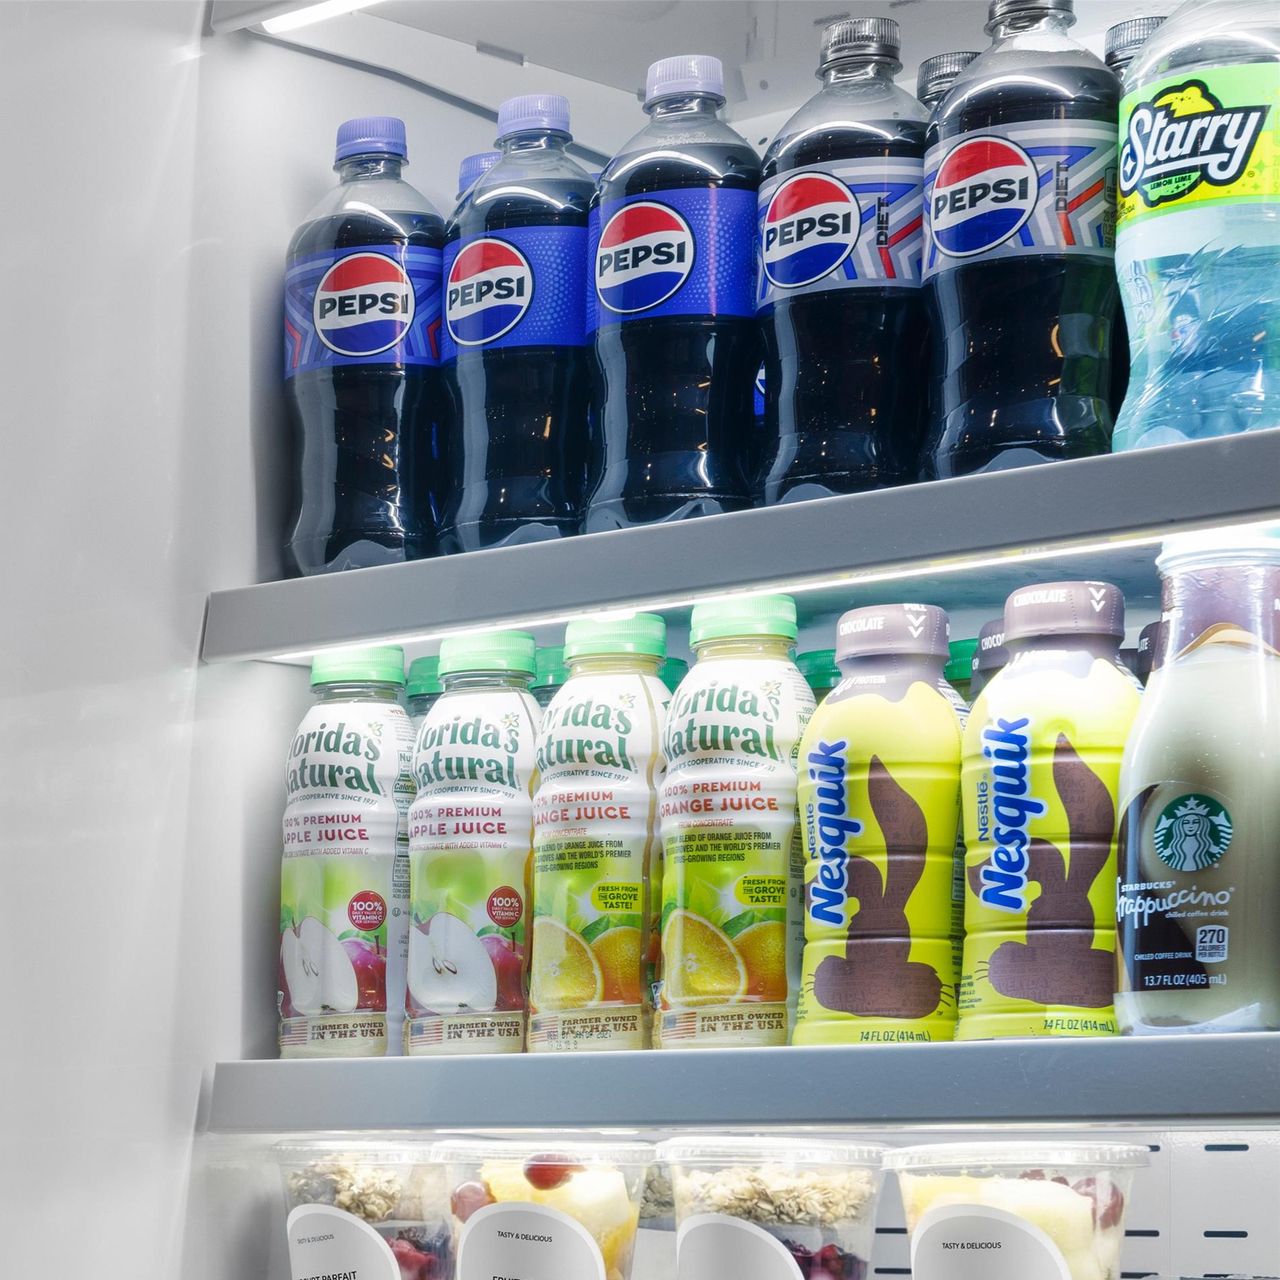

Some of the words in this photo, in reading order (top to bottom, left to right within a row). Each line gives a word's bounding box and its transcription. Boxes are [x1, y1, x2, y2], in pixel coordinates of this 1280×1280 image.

[1120, 108, 1261, 192] Starry
[1054, 161, 1068, 212] DIET
[1150, 178, 1172, 190] LEMON
[1174, 175, 1192, 183] LIME
[934, 176, 1029, 220] PEPSI
[876, 197, 890, 246] DIET
[765, 211, 851, 251] PEPSI
[599, 241, 686, 277] PEPSI
[448, 276, 525, 311] PEPSI
[318, 292, 409, 319] PEPSI
[1013, 589, 1068, 607] CHOCOLATE
[840, 616, 885, 635] CHOCOLATE
[692, 781, 761, 793] PREMIUM
[438, 808, 501, 817] PREMIUM
[660, 799, 713, 817] ORANGE
[720, 797, 779, 811] JUICE
[983, 718, 1044, 910] Nesquik
[410, 823, 446, 838] APPLE
[453, 823, 507, 835] JUICE
[810, 740, 861, 925] Nesquik
[1121, 882, 1172, 892] STARBUCKS
[492, 897, 519, 907] 100%
[1199, 929, 1225, 943] 270
[1144, 976, 1161, 986] 13.7
[1163, 976, 1172, 985] FL
[1175, 975, 1185, 985] OZ
[1186, 975, 1206, 985] (405
[1209, 974, 1227, 985] mL)
[447, 1031, 462, 1039] IN
[467, 1029, 495, 1038] THE
[498, 1028, 520, 1037] USA
[448, 1021, 487, 1030] FARMER
[1043, 1019, 1053, 1030] 14
[1054, 1020, 1067, 1030] FL
[1068, 1021, 1080, 1030] OZ
[1081, 1020, 1097, 1032] (414
[1098, 1021, 1114, 1033] mL)
[497, 1231, 515, 1239] TASTY
[521, 1234, 552, 1242] DELICIOUS
